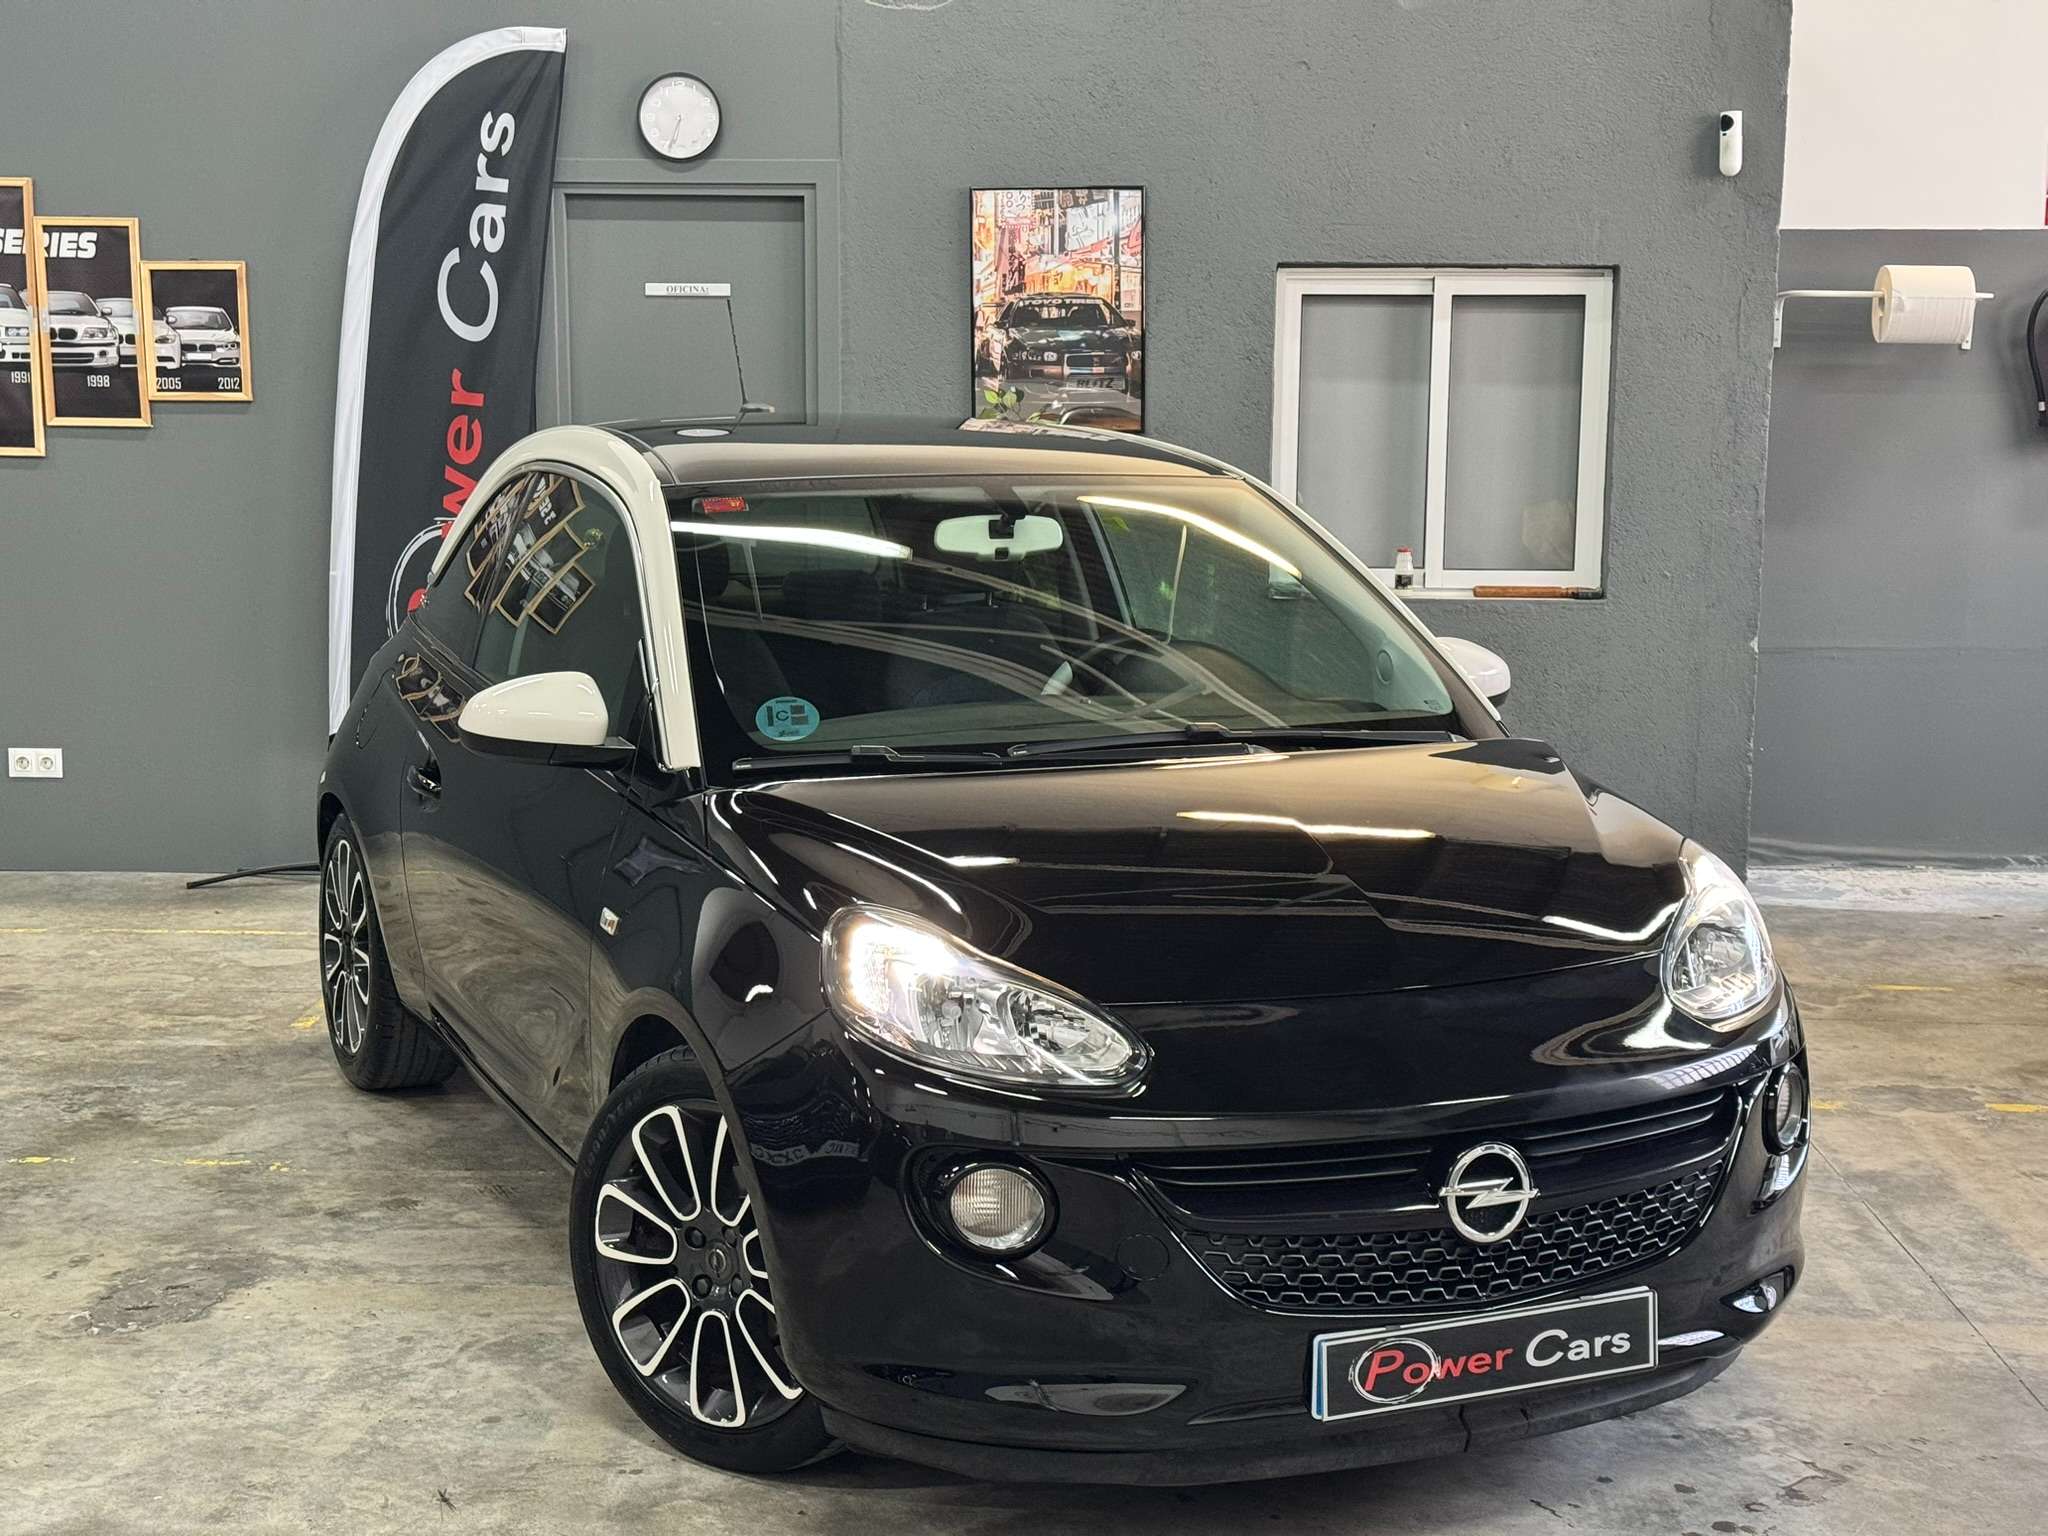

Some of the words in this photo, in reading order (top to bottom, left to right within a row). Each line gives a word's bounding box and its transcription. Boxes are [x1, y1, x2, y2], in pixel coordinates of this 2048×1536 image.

[437, 110, 515, 342] Cars
[87, 375, 110, 388] 1998
[156, 377, 182, 390] 2005
[218, 377, 240, 390] 2012
[1364, 1348, 1514, 1392] Power
[1525, 1329, 1632, 1367] Cars
